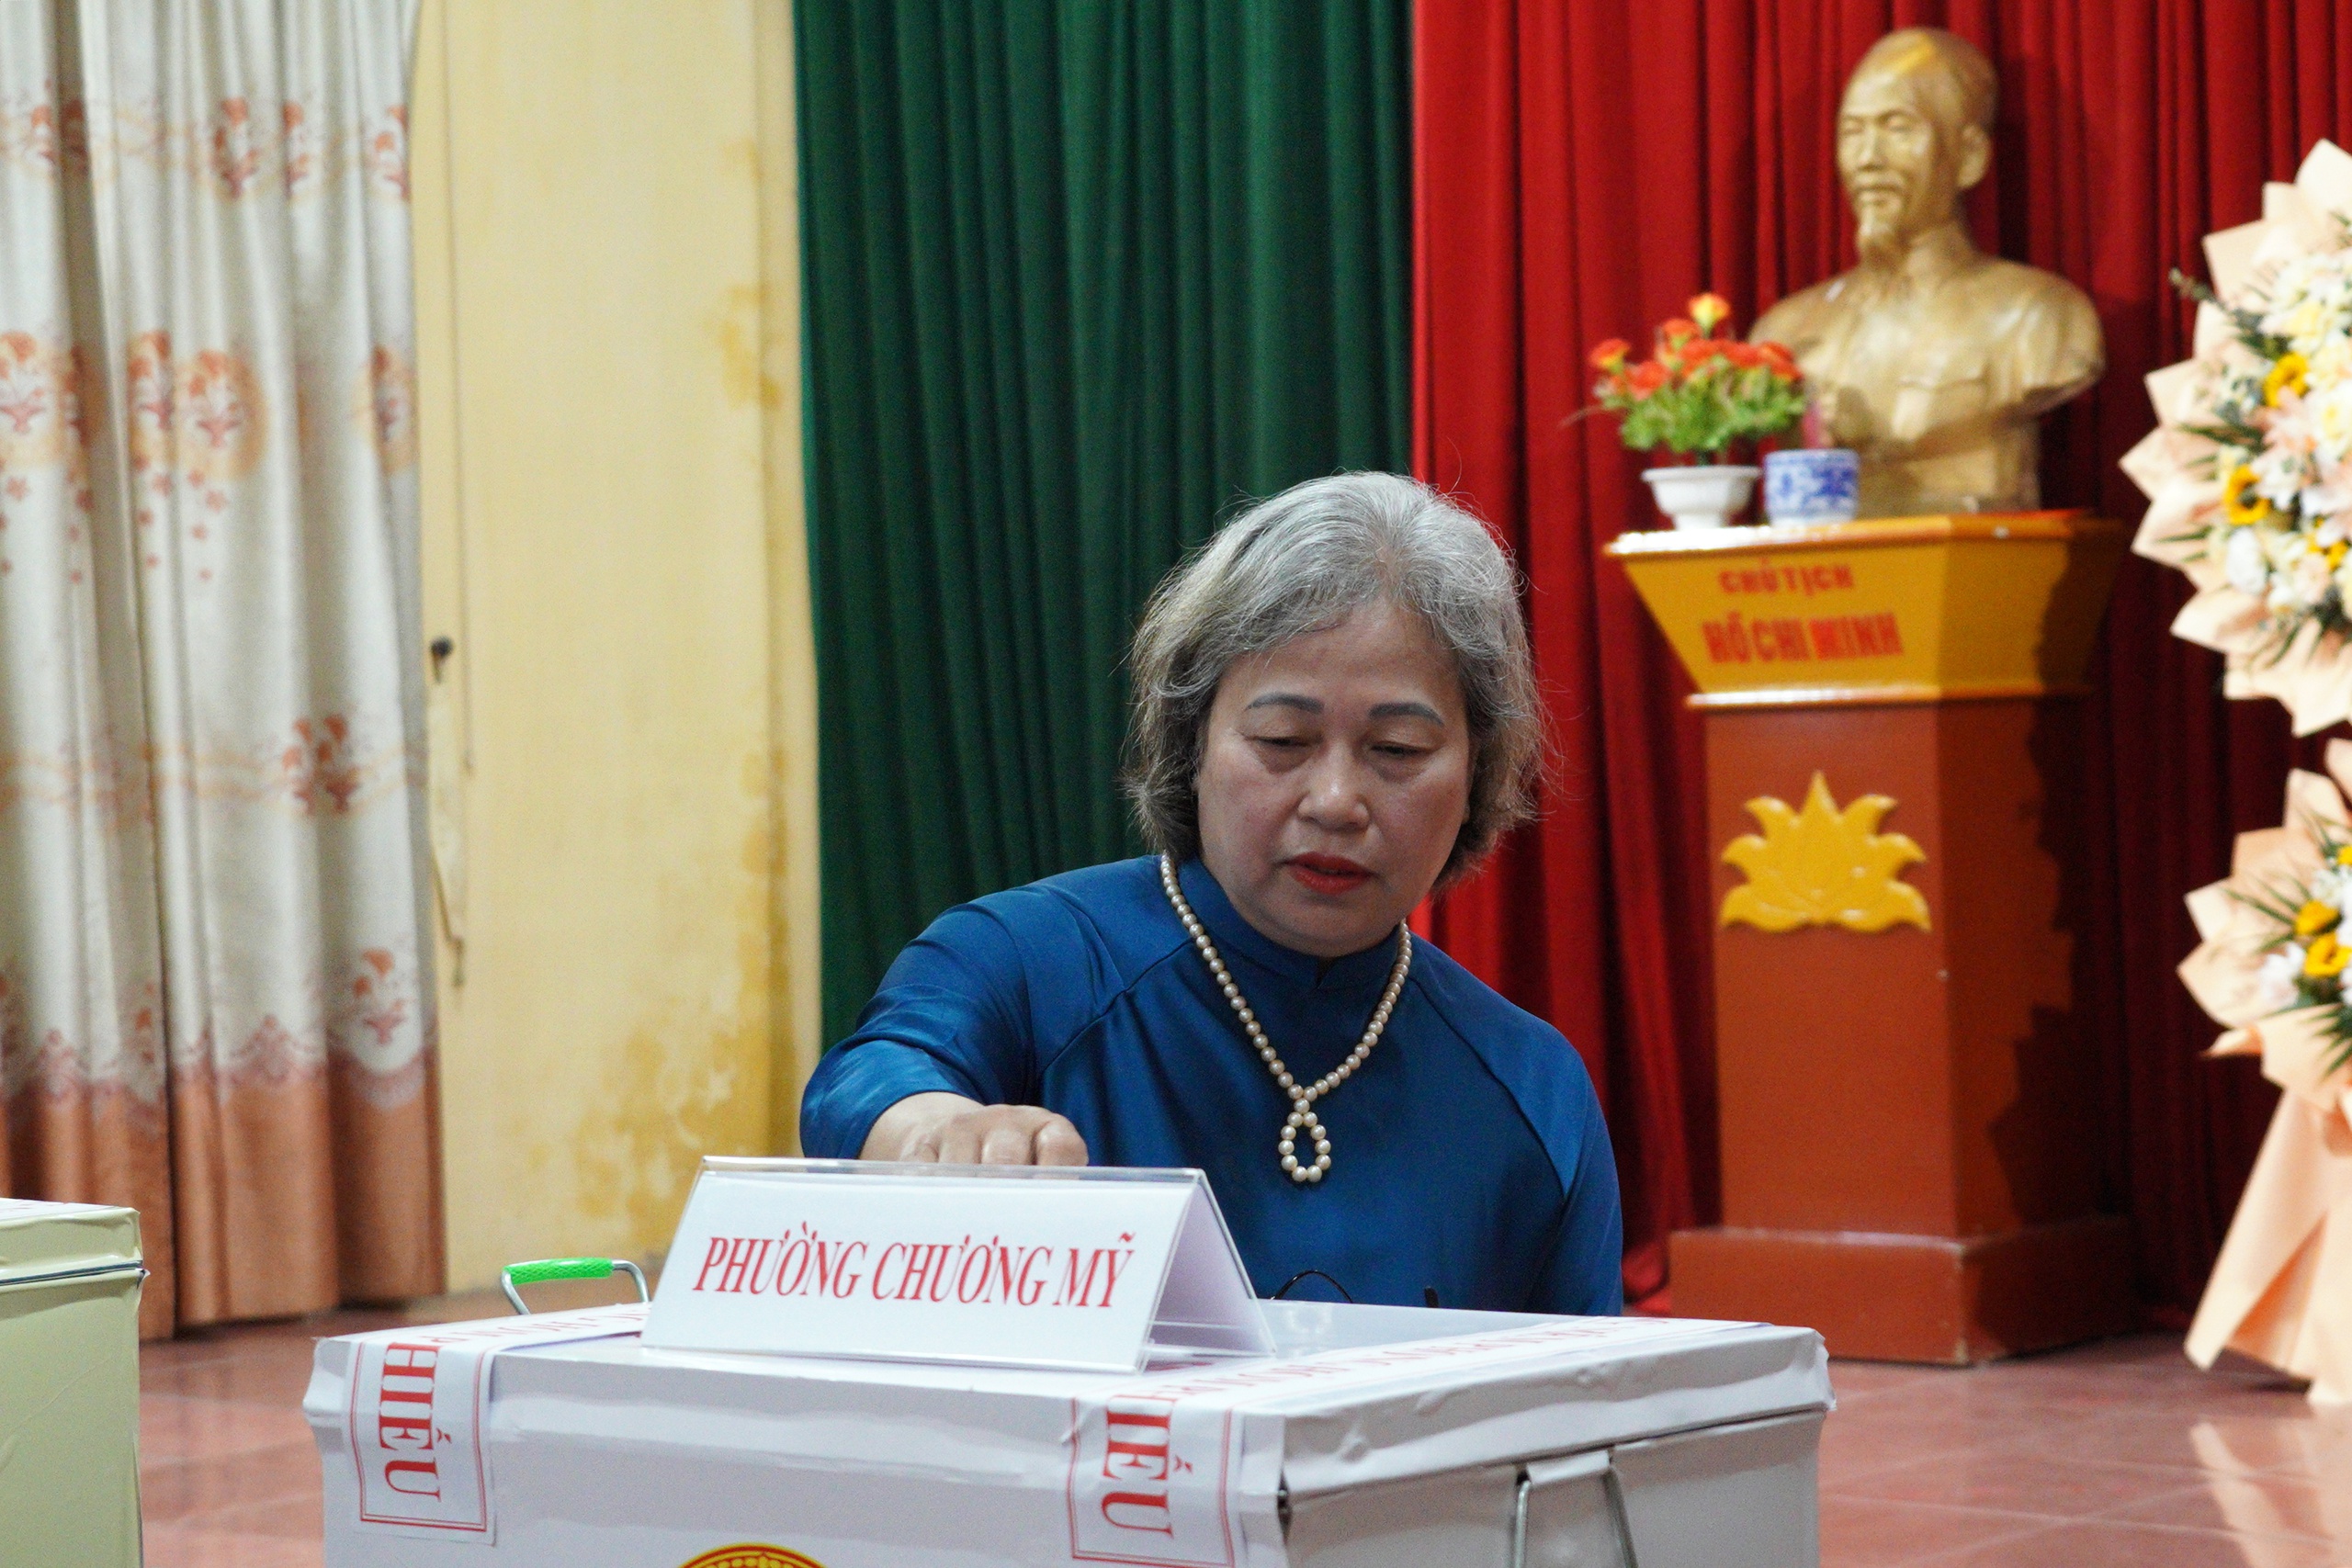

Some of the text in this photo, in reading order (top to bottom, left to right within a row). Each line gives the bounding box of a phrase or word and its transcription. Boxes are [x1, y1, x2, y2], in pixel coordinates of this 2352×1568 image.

[1807, 611, 1905, 661] MINH
[692, 1220, 1136, 1308] PHƯỜNG CHƯƠNG MỸ
